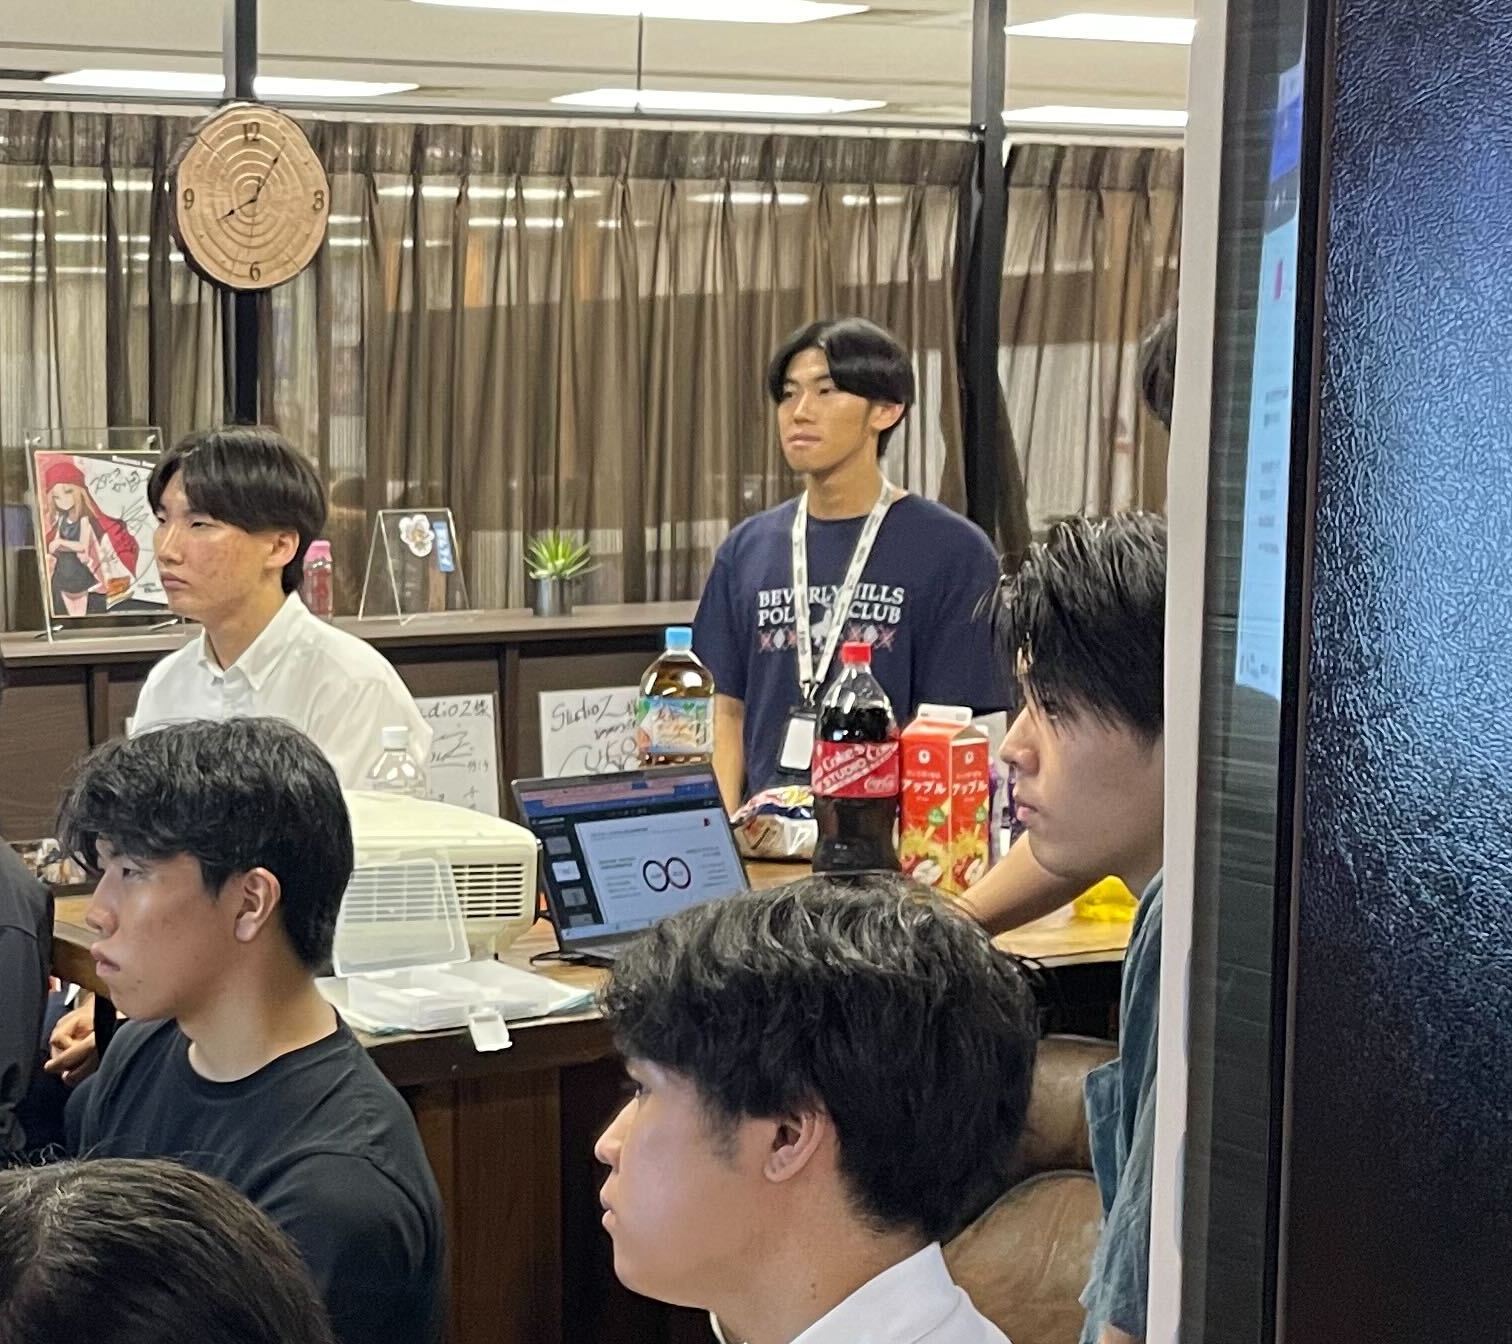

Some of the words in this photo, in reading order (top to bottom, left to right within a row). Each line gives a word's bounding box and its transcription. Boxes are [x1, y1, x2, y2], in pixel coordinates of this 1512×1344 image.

[243, 121, 261, 142] 12
[183, 187, 195, 210] 9
[249, 261, 261, 282] 6
[758, 585, 839, 608] BEVRLY
[758, 606, 795, 626] POL
[848, 601, 901, 624] CLUB
[901, 779, 947, 795] アップル
